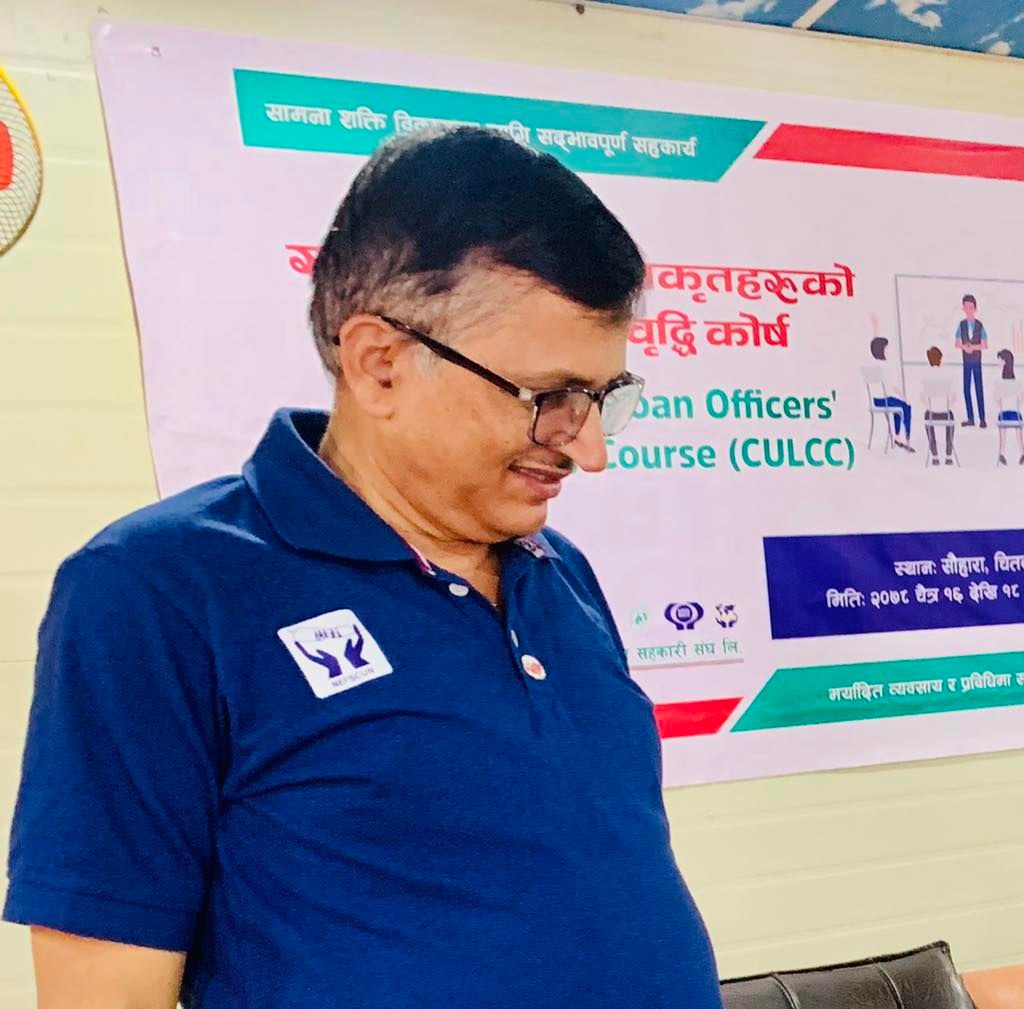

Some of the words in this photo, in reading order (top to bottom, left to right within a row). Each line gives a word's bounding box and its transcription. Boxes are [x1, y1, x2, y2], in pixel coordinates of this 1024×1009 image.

[337, 106, 387, 130] शक्ति
[643, 263, 855, 304] कृतहरूको
[704, 312, 790, 348] कोर्ष
[631, 393, 693, 419] oan
[705, 388, 837, 420] Officers'
[729, 437, 855, 472] (CULCC)
[870, 589, 909, 609] २०७८
[969, 581, 998, 604] देखि
[637, 641, 687, 660] सहकारी
